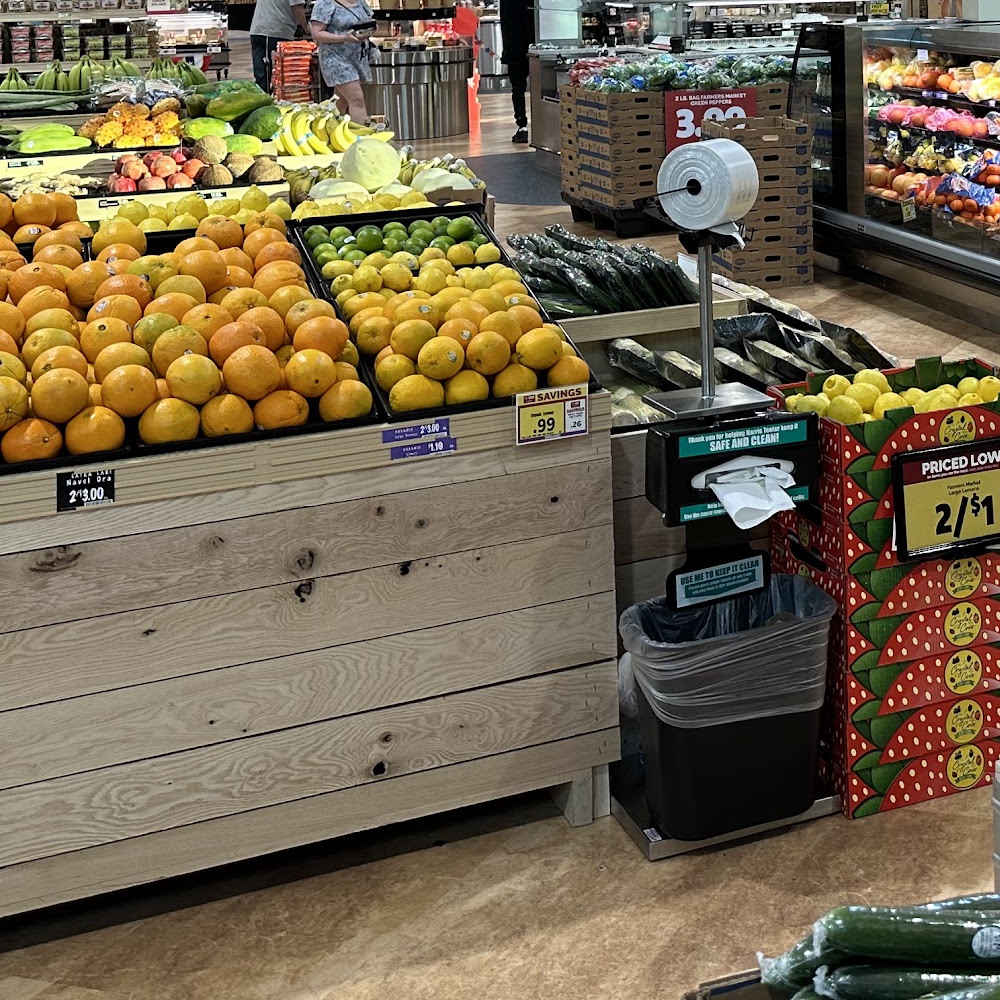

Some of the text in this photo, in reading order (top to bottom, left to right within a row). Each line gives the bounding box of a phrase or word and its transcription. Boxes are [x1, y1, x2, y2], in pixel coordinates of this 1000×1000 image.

[537, 388, 582, 401] SAVINGS
[533, 417, 556, 434] .99
[571, 420, 582, 428] .26
[725, 431, 745, 440] helping
[746, 429, 763, 437] Harris
[763, 426, 780, 434] Teeter
[709, 432, 779, 452] SAFE AND CLEAN!
[921, 456, 968, 475] PRICED
[66, 477, 90, 486] Navel
[935, 492, 995, 538] 2/$1
[680, 575, 693, 585] USE
[695, 572, 704, 581] ME
[705, 570, 714, 579] TO
[715, 566, 731, 577] KEEP
[732, 564, 738, 572] IT
[740, 559, 759, 570] CLEAN
